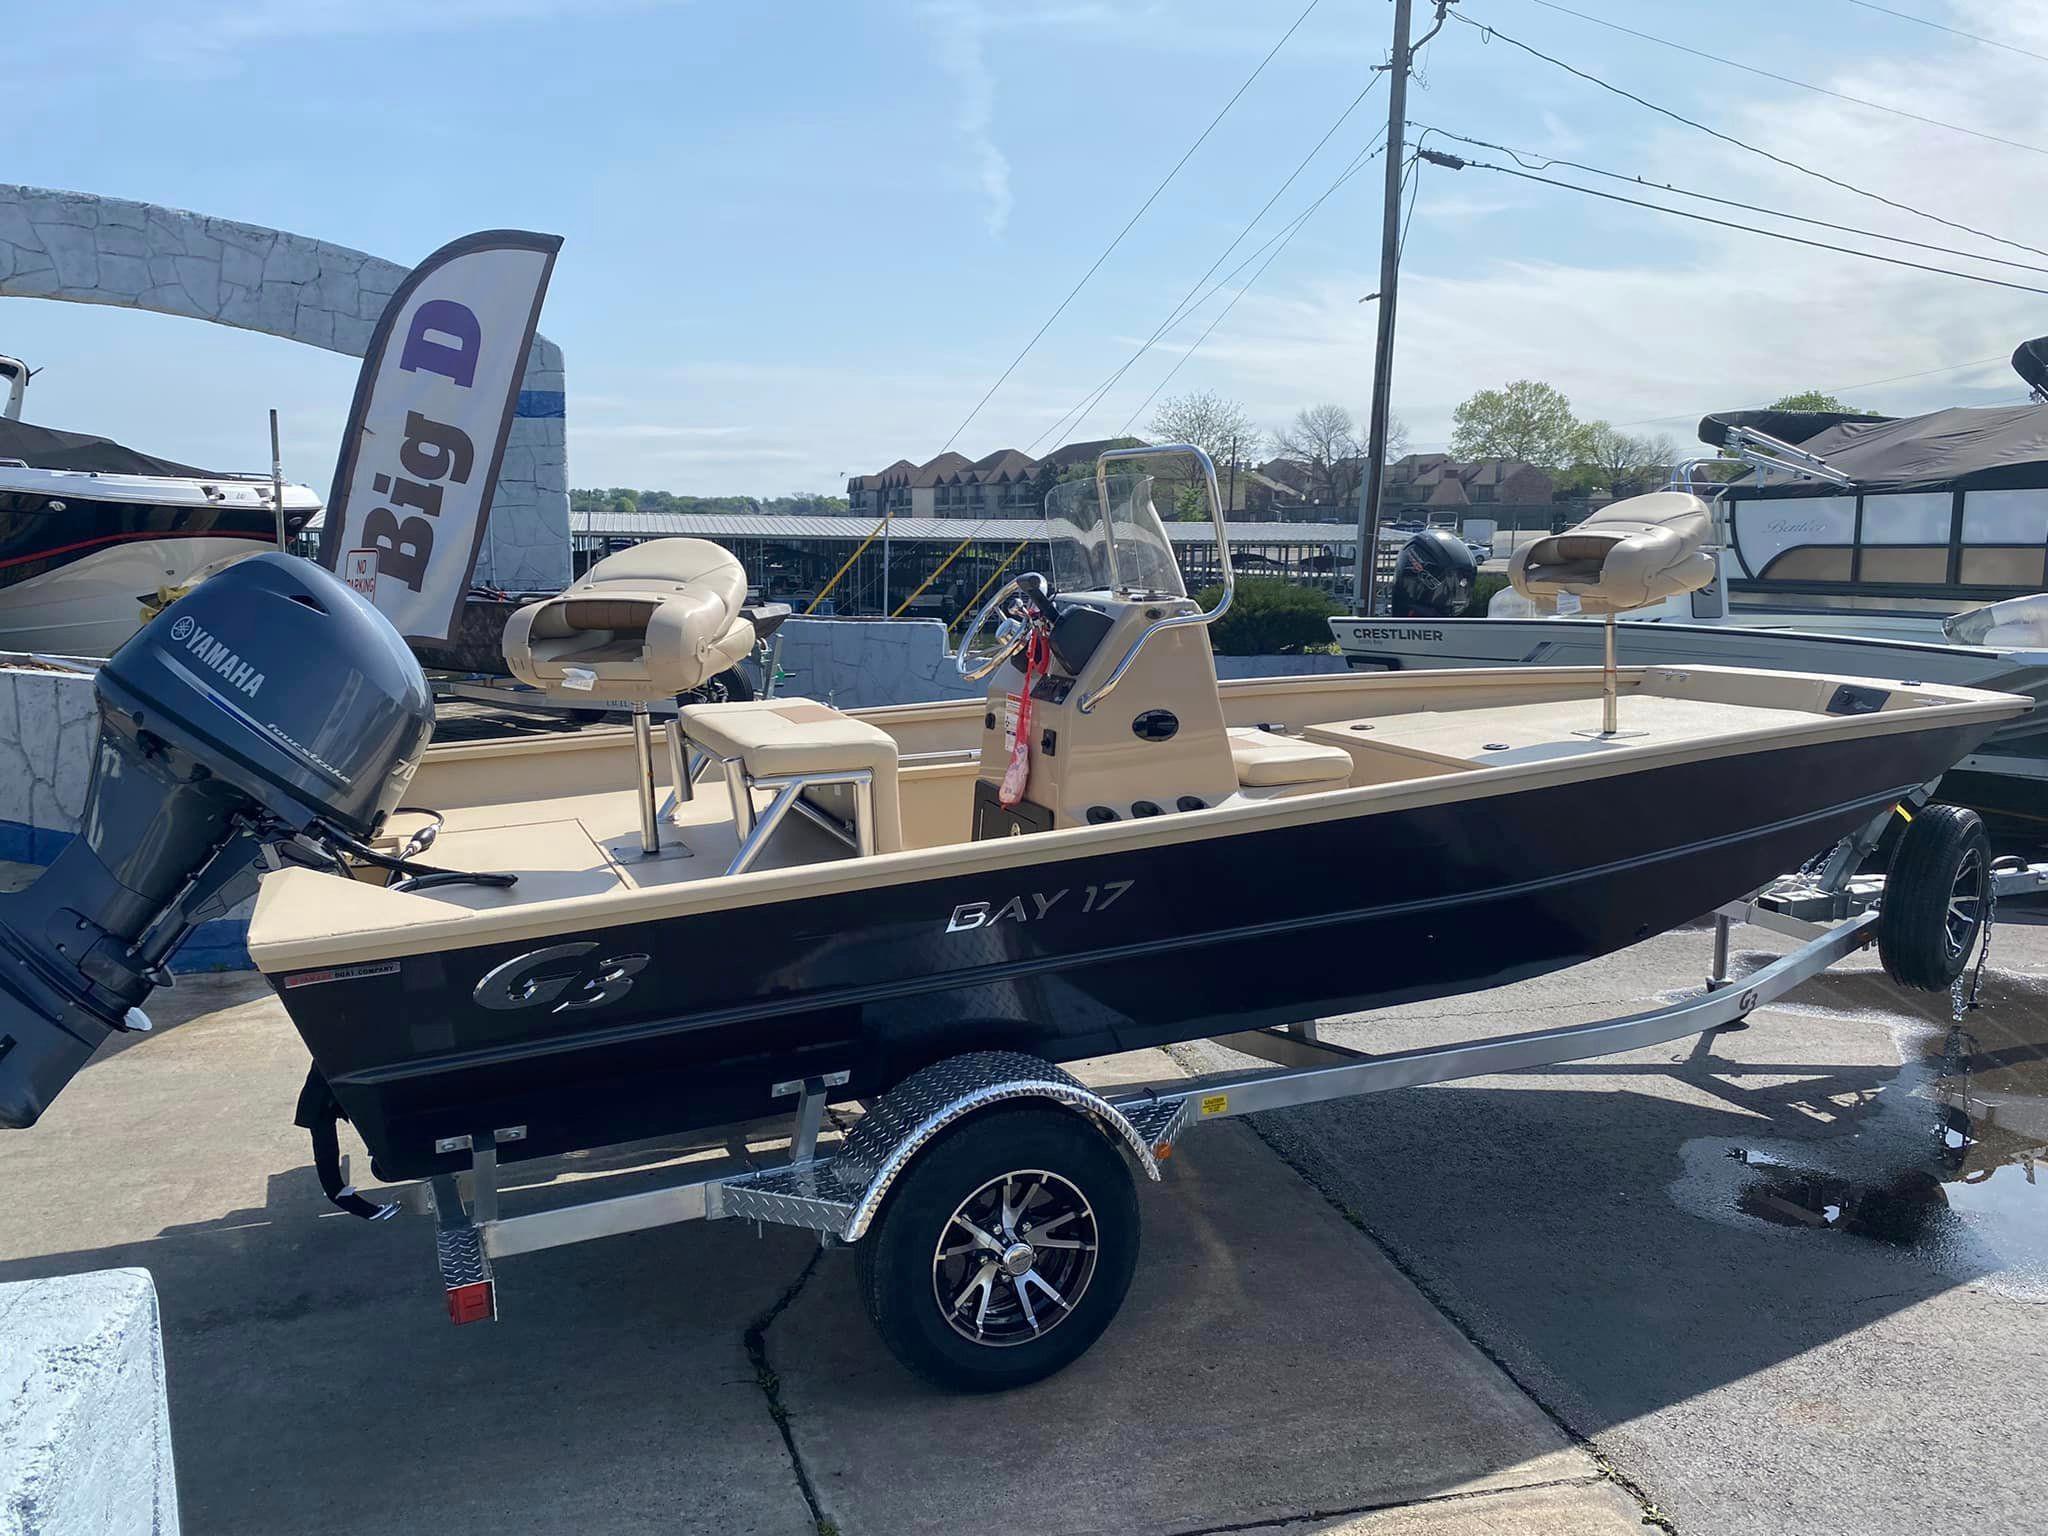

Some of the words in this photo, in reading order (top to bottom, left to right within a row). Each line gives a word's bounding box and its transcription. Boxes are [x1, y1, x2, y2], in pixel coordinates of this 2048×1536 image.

[400, 299, 482, 389] D
[362, 410, 475, 593] Big
[357, 559, 367, 574] NO
[186, 626, 265, 698] YAMAHA
[1353, 628, 1443, 641] CRESTLINER
[267, 723, 351, 784] fourstroke
[392, 758, 417, 781] 70
[945, 889, 1070, 934] BAY
[1082, 880, 1135, 913] 17
[473, 942, 652, 1013] G3
[1739, 988, 1758, 1011] G3
